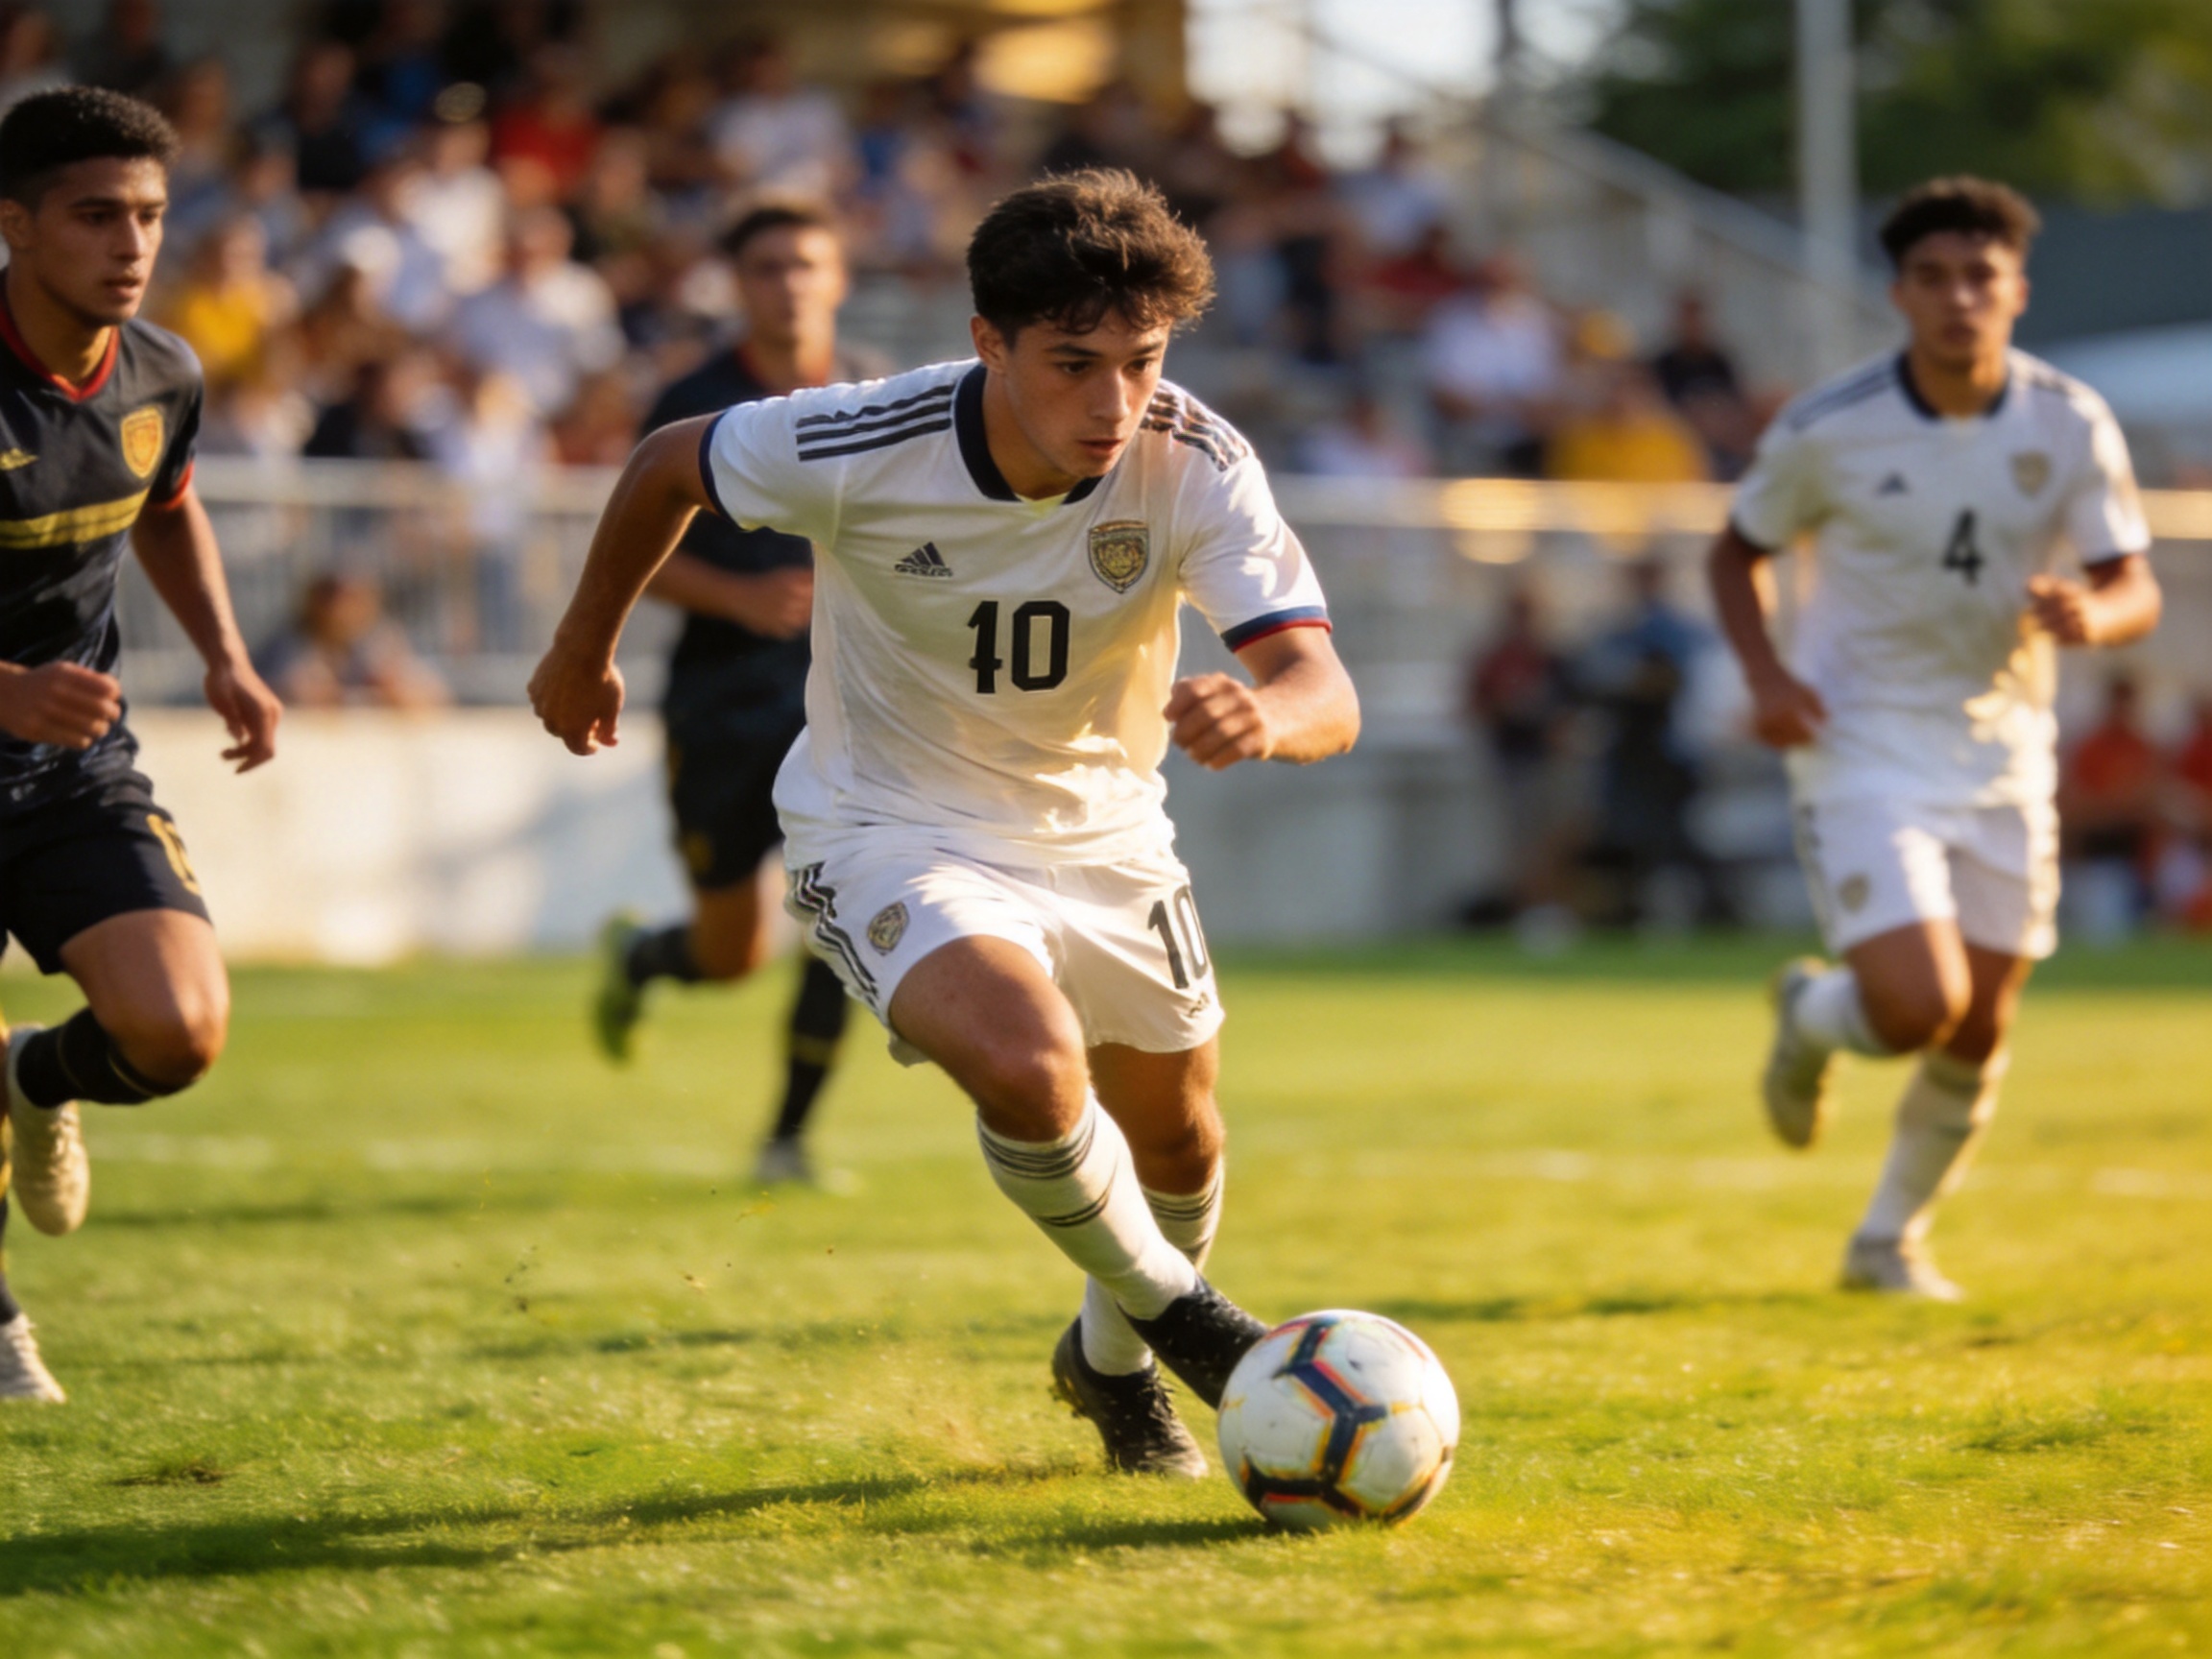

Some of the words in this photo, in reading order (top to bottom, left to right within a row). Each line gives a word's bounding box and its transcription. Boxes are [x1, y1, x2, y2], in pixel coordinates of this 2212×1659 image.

[1943, 508, 1984, 588] 4
[967, 600, 1070, 693] 10
[1147, 884, 1209, 989] 10
